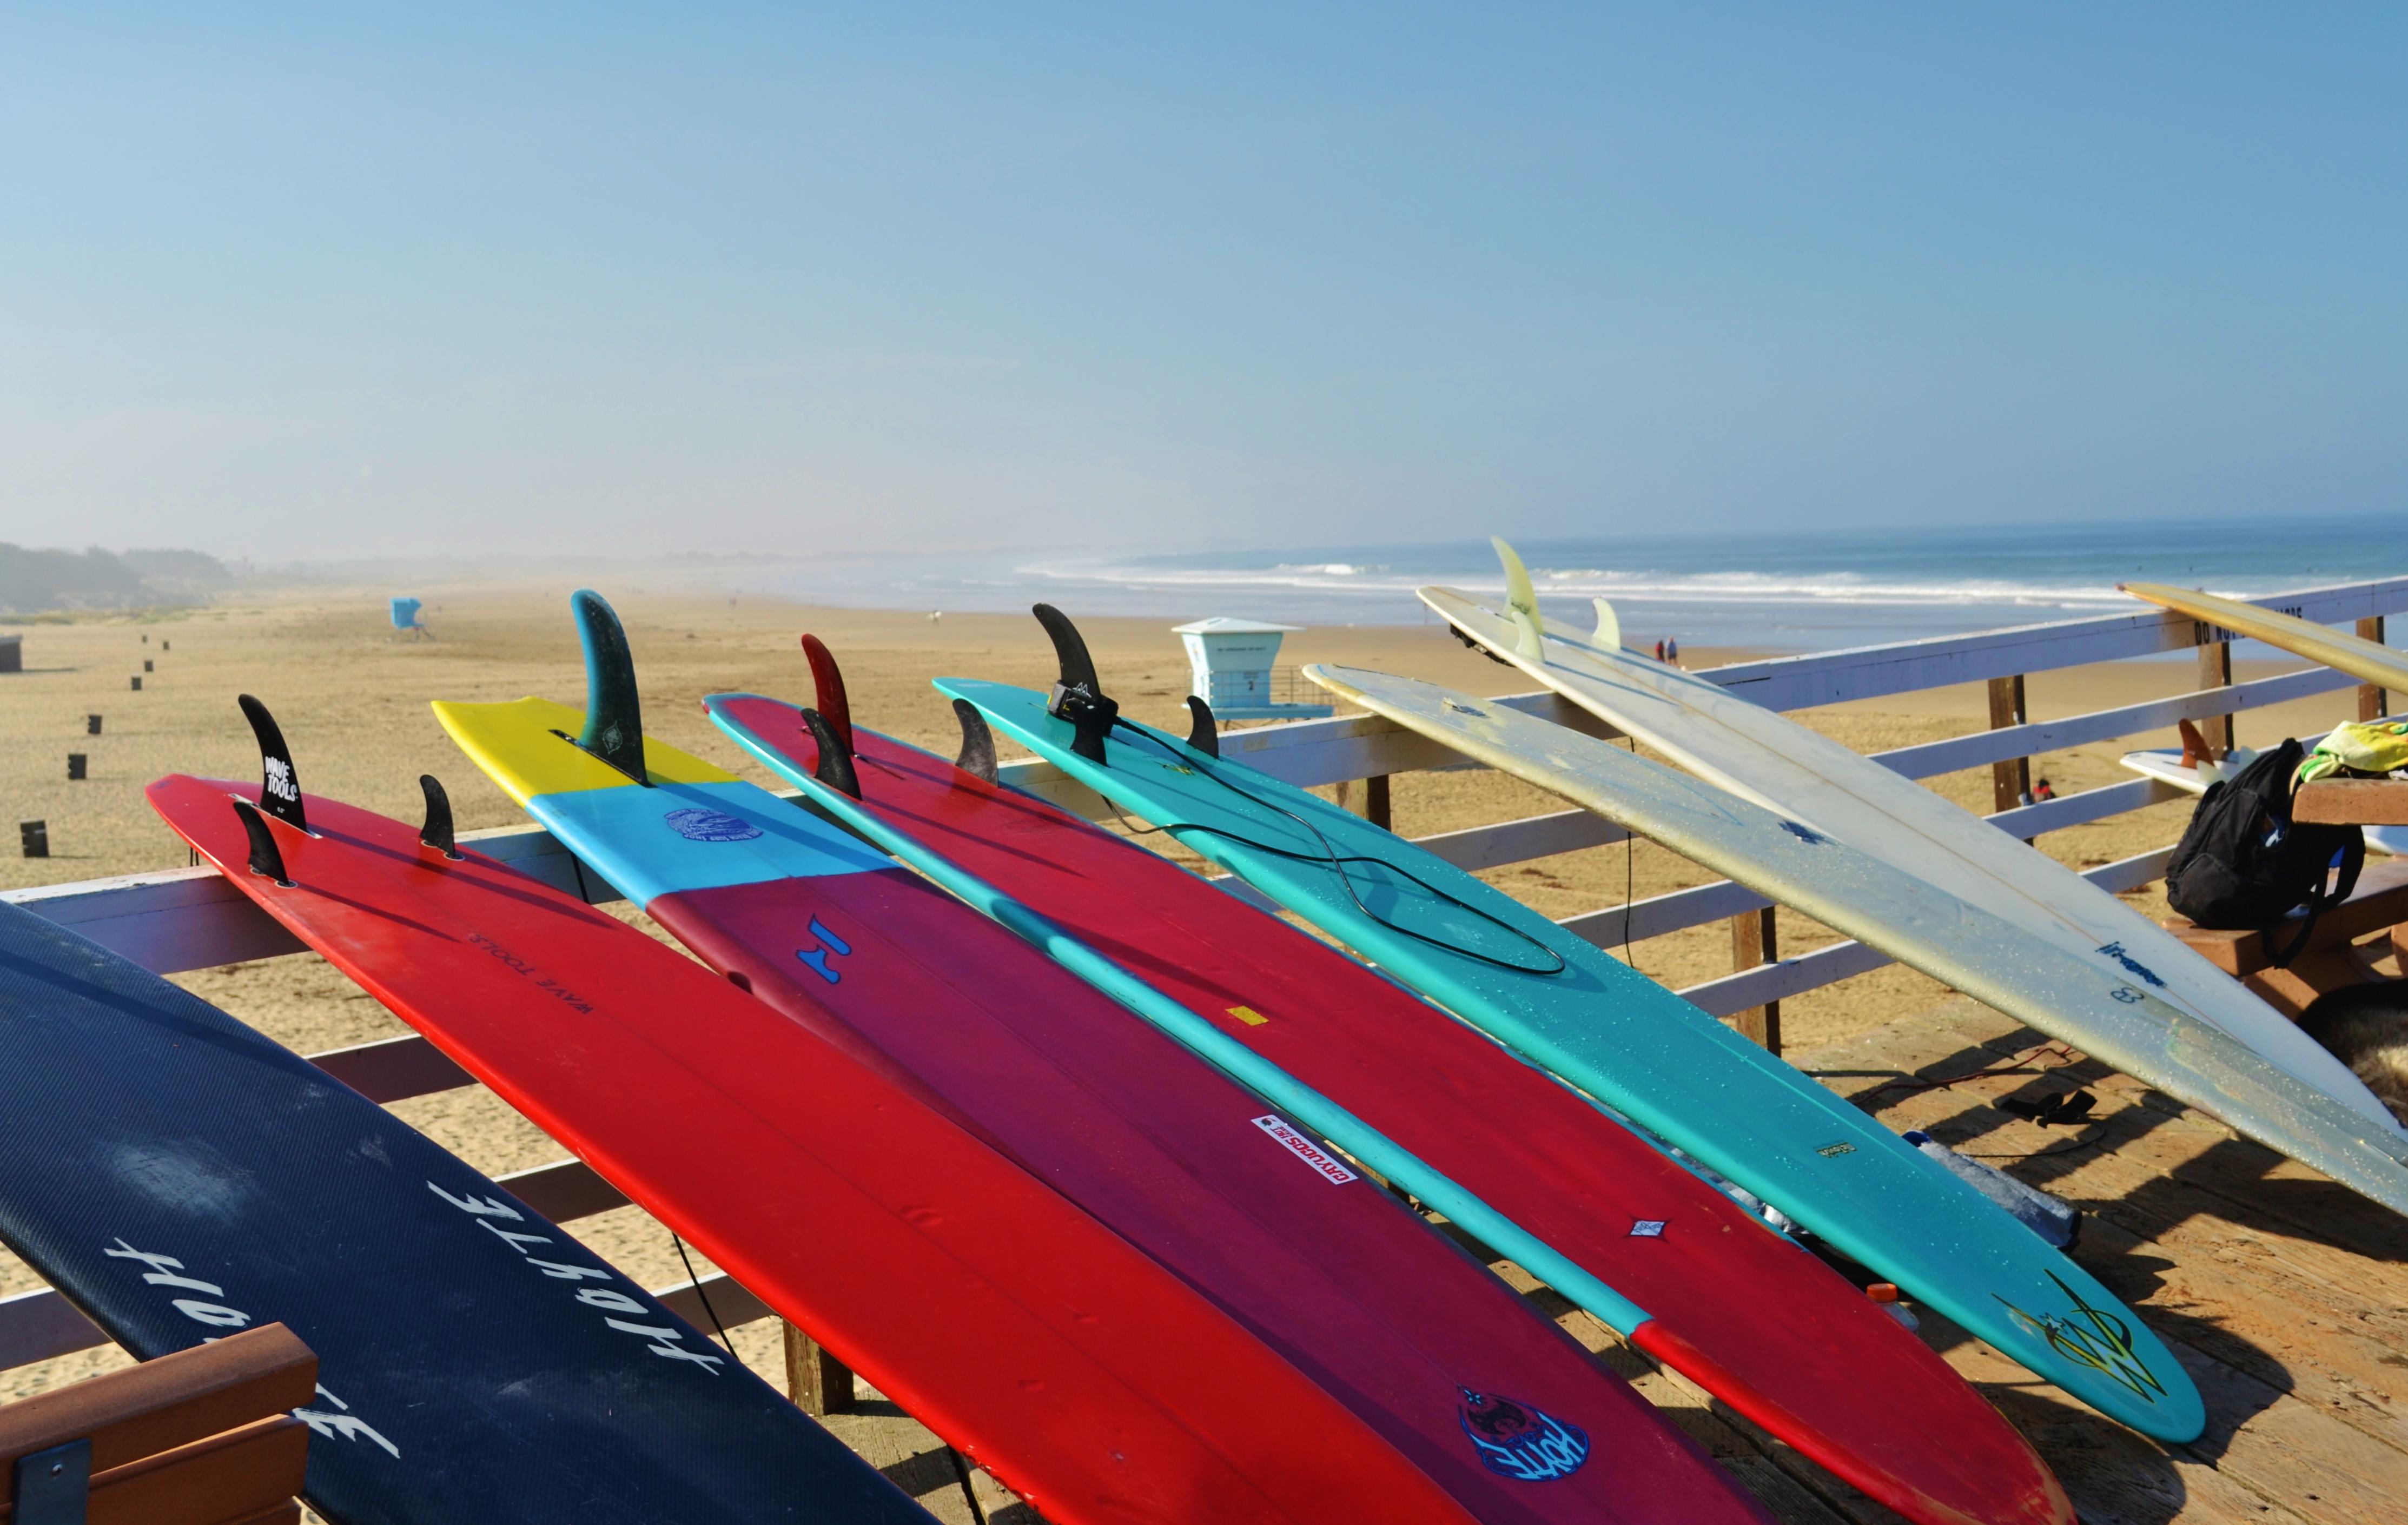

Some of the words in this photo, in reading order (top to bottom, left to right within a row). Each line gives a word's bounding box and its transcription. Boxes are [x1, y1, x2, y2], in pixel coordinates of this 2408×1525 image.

[2195, 621, 2209, 645] DO
[265, 756, 290, 783] WAVE
[268, 774, 297, 802] TOOLS
[469, 934, 535, 976] TOOLS
[537, 979, 593, 1015] WAVE
[1269, 1125, 1289, 1139] HOT
[1286, 1136, 1349, 1181] CAYUCOS
[427, 1181, 724, 1376] HOYTE
